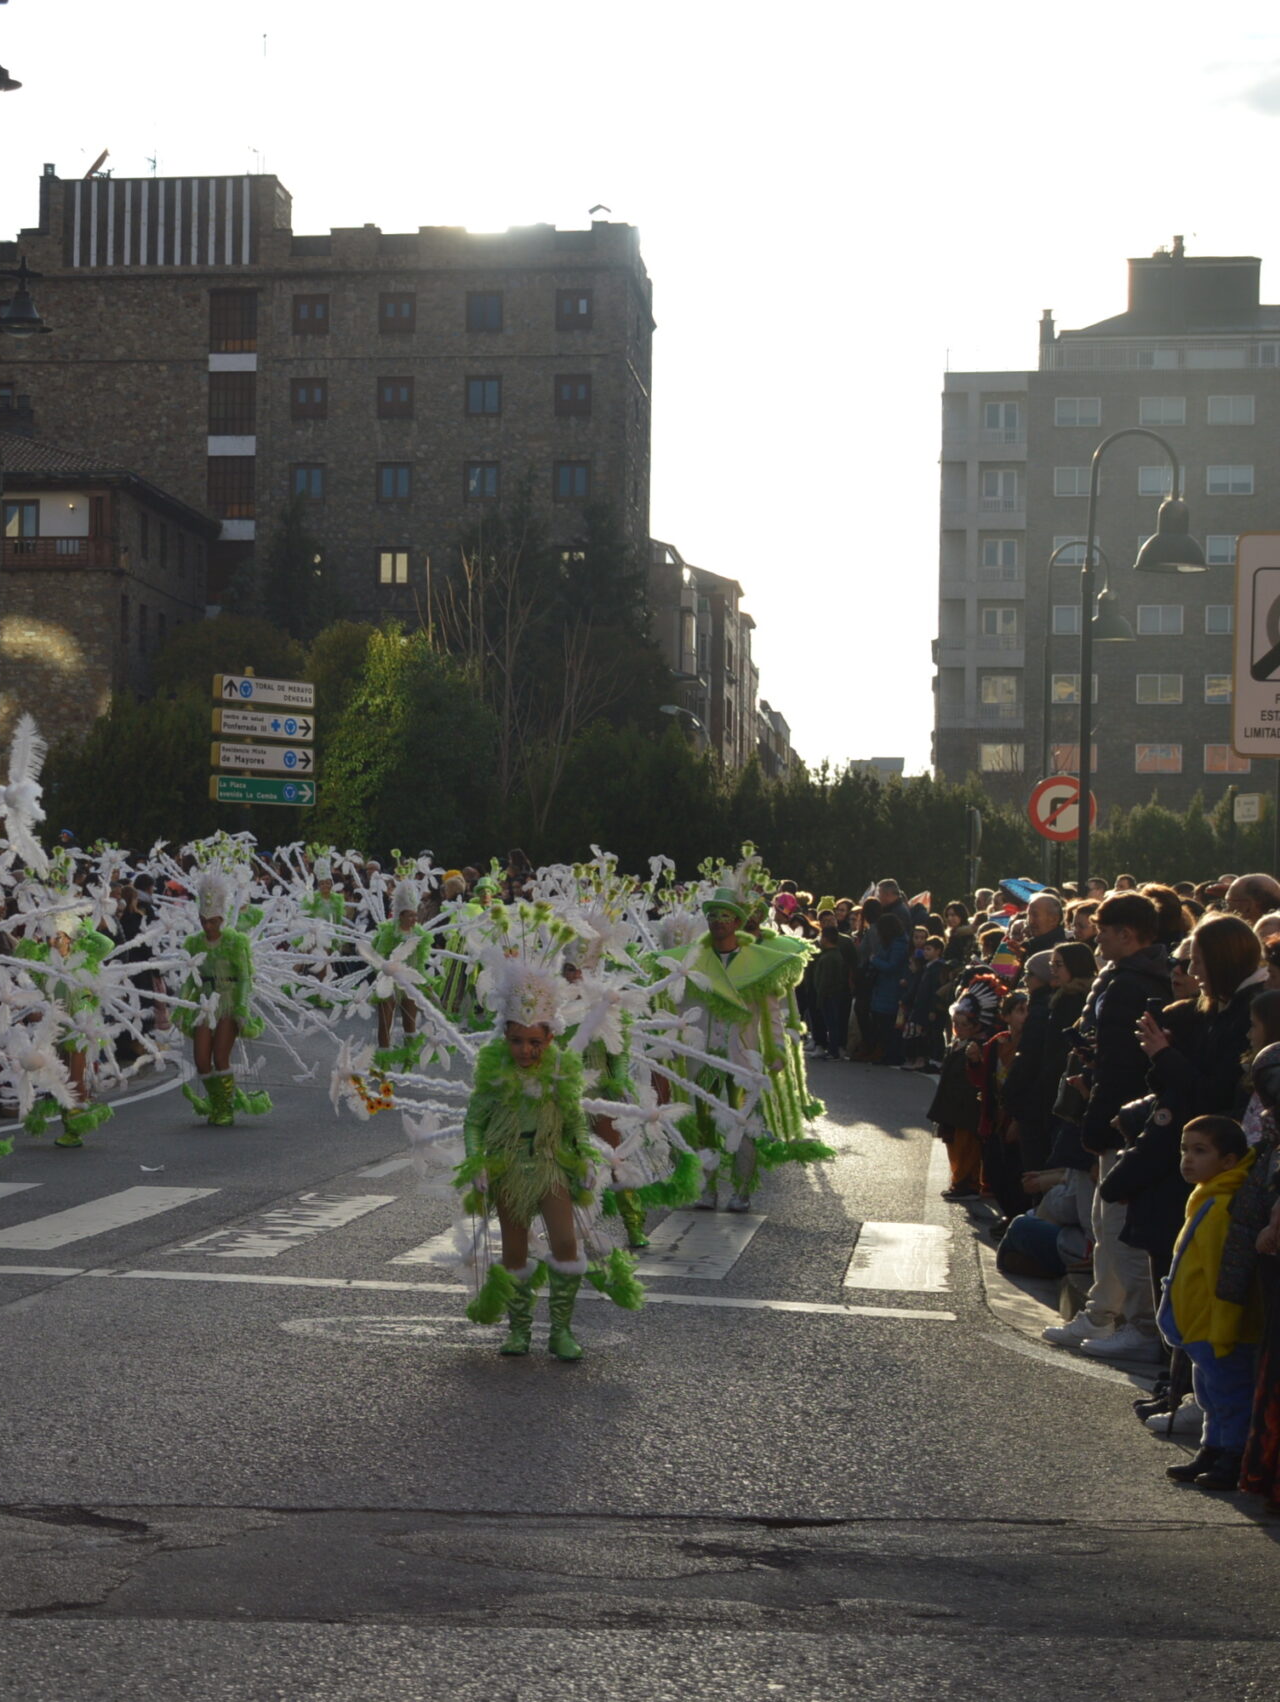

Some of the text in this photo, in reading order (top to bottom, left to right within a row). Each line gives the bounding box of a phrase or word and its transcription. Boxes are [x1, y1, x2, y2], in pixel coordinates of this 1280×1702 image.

[255, 682, 274, 691] TORAL
[288, 686, 313, 695] MERAYO
[283, 694, 312, 704] DEHESAS
[1260, 710, 1280, 721] EST
[221, 754, 265, 765] de Mayores
